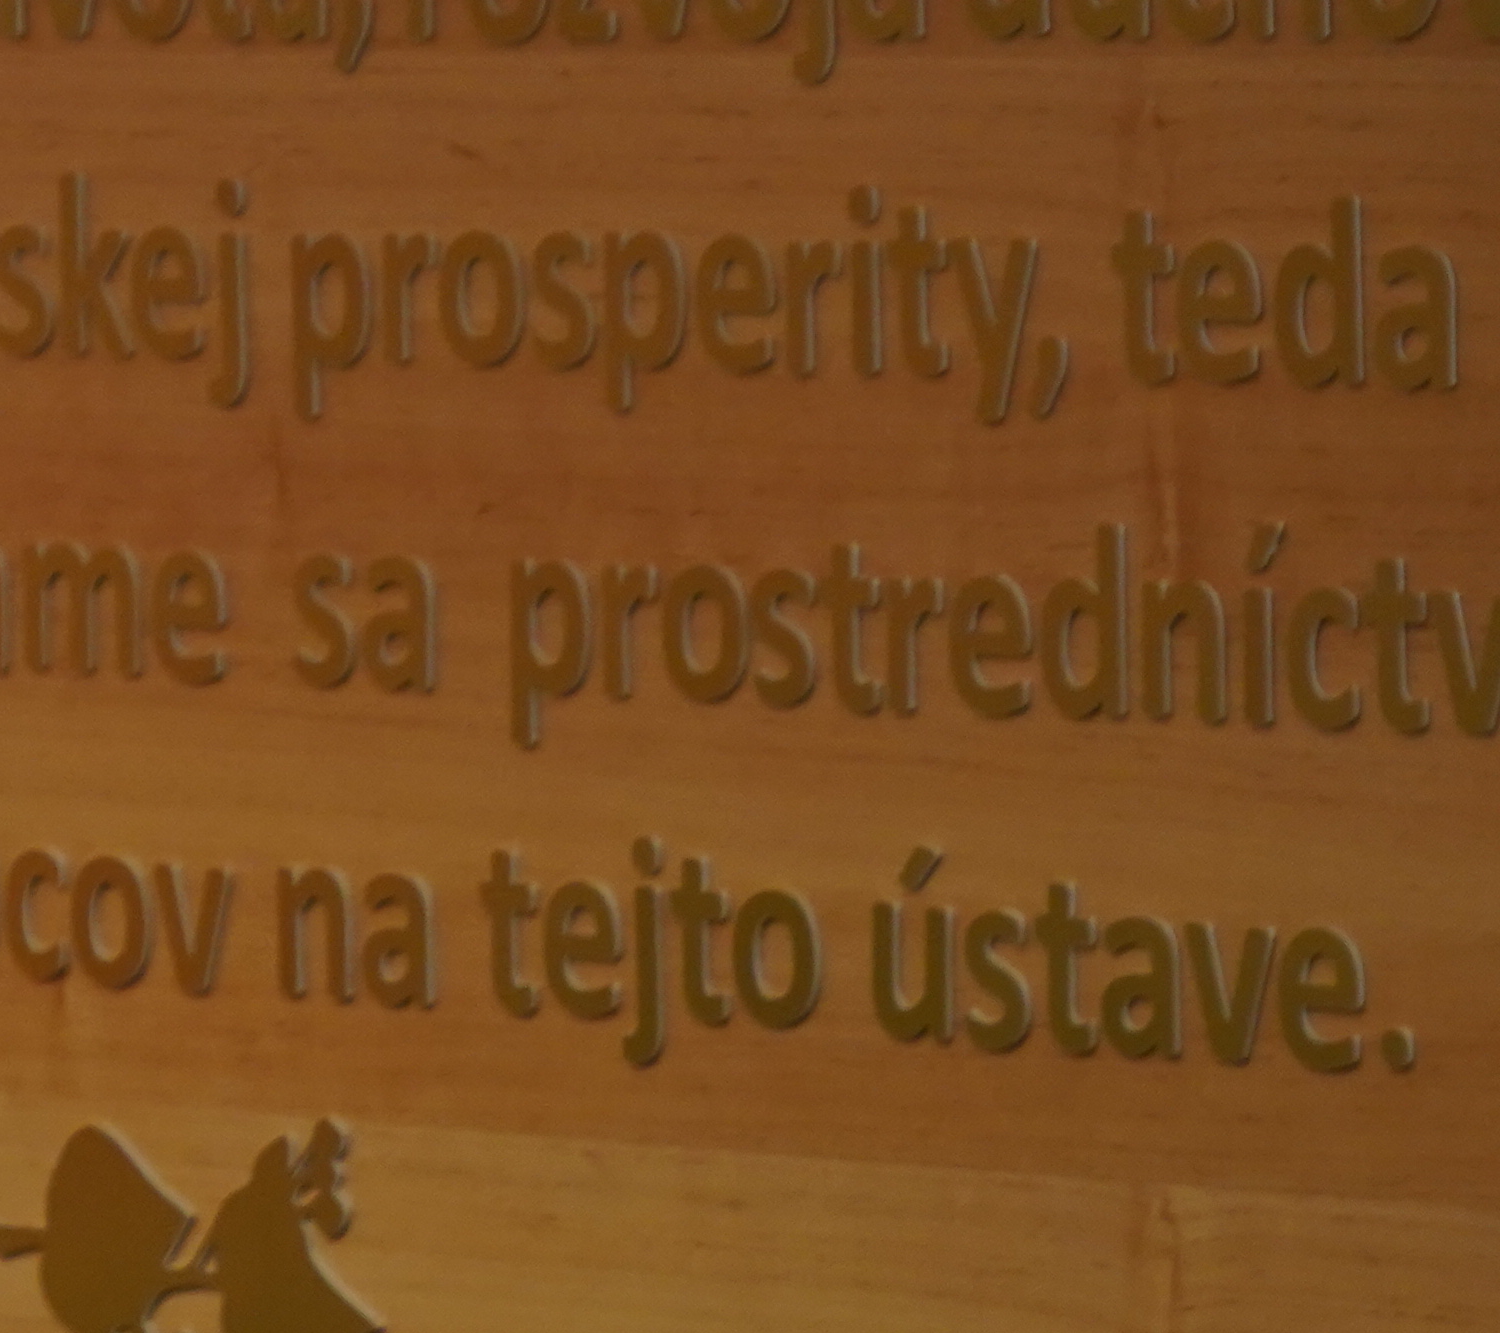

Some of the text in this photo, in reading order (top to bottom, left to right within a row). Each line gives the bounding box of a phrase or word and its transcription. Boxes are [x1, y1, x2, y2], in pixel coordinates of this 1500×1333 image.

[289, 184, 1072, 424] prosperity,
[1111, 197, 1461, 390] teda
[293, 553, 443, 694] sa
[512, 521, 1500, 747] prostredníctv
[275, 855, 440, 1014] na
[483, 835, 823, 1067] tejto
[871, 846, 1418, 1073] ústave.
